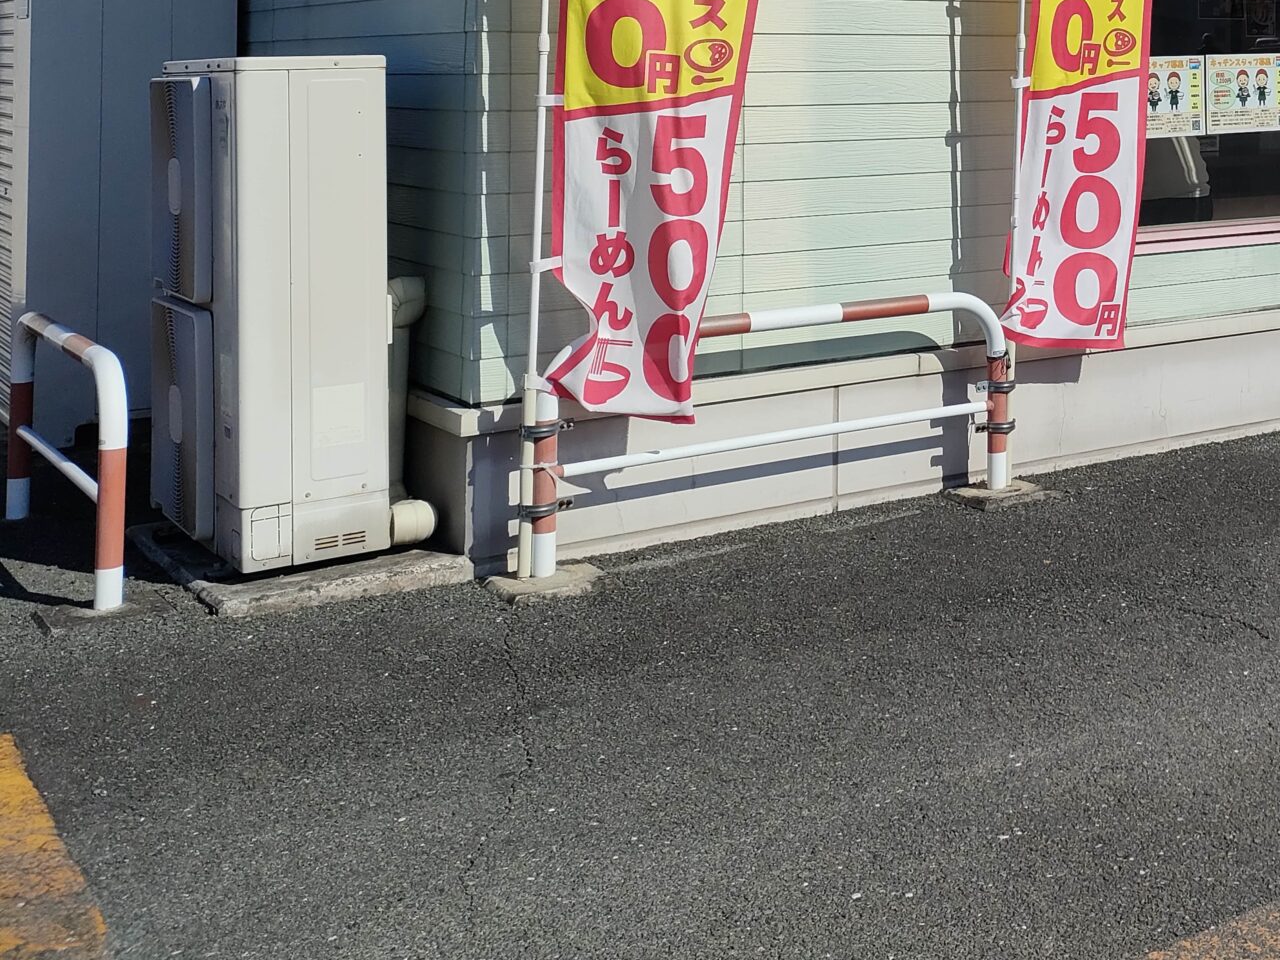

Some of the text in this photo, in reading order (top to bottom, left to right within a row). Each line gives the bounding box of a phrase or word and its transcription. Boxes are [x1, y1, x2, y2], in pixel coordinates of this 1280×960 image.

[589, 127, 634, 329] らーめん
[1027, 105, 1067, 279] らーめん
